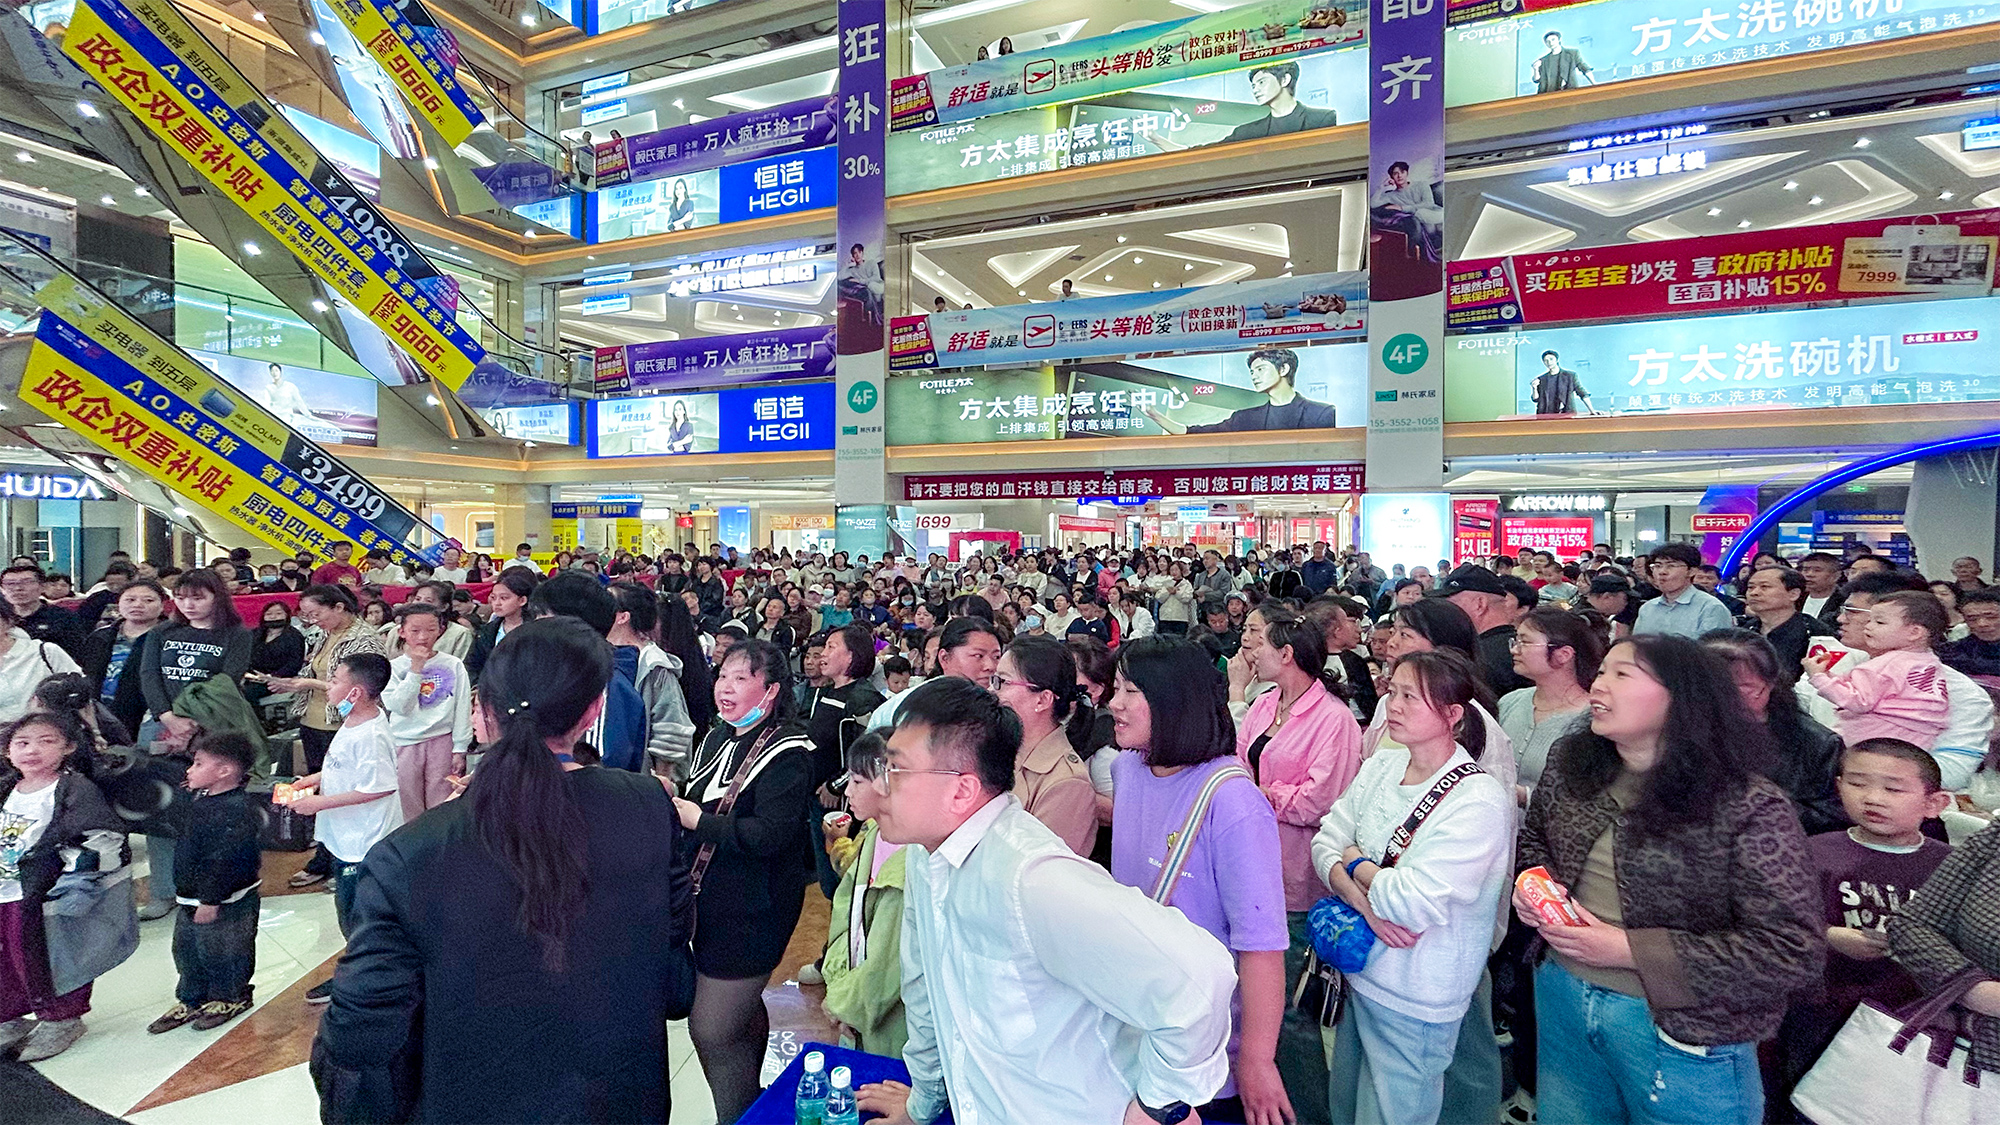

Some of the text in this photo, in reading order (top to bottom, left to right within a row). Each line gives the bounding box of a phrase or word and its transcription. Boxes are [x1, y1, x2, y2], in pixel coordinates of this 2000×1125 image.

[1188, 29, 1238, 49] 政企双补
[1459, 19, 1533, 41] FOTILE方太
[1631, 0, 1903, 57] 方太洗碗机
[134, 2, 231, 93] 买电器 到五层
[381, 5, 455, 90] 春季家装节
[1156, 44, 1173, 66] 沙发
[1189, 44, 1238, 62] 以旧换新
[1631, 40, 1791, 76] 颠覆传统水洗技术
[1807, 13, 1962, 48] 发明高能气泡洗
[1091, 47, 1154, 79] 头等舱
[387, 54, 444, 114] 9666
[947, 80, 1019, 108] 舒适 就是
[75, 33, 265, 202] 政企双重补贴
[435, 115, 445, 126] 元
[1196, 103, 1216, 114] X20
[704, 110, 827, 151] 万人疯狂抢工厂
[920, 123, 975, 142] FOTILE方太
[960, 107, 1192, 169] 方太集成烹饪中心
[843, 155, 880, 180] 30%
[997, 143, 1146, 178] 上排集成 引领高端厨电
[754, 161, 804, 190] 恒洁
[748, 187, 810, 213] HEGII
[259, 210, 361, 300] 热水器 净水机 油烟机 燃气灶
[272, 202, 369, 290] 厨电四件套
[1525, 245, 1835, 294] 买乐至宝沙发 享政府补贴
[1858, 271, 1897, 282] 7999
[1450, 278, 1504, 295] 无居然合同
[1451, 287, 1511, 305] 谁来保护你?
[1674, 272, 1827, 302] 至高补贴15%
[369, 291, 403, 323] 低至
[384, 267, 458, 337] 春季家装节
[1188, 305, 1238, 320] 政企双补
[1090, 314, 1155, 340] 头等舱
[1155, 312, 1173, 335] 沙发
[1188, 318, 1238, 333] 以旧换新
[390, 314, 445, 364] 9666
[947, 329, 1019, 353] 舒适 就是
[1458, 335, 1532, 349] FOTILE方太
[96, 320, 198, 392] 买电器 到五层
[703, 340, 826, 369] 万人疯狂抢工厂
[1388, 343, 1421, 365] 4F
[1628, 334, 1900, 388] 方太洗碗机
[437, 362, 447, 373] 元
[919, 377, 974, 389] FOTILE方太
[1194, 385, 1215, 395] X20
[1401, 390, 1436, 399] 林氏家居
[1628, 378, 1981, 408] 颠覆传统水洗技术 发明高能气泡洗 3.0
[753, 396, 805, 421] 恒洁
[852, 389, 873, 405] 4F
[958, 386, 1190, 422] 方太集成烹饪中心
[123, 381, 241, 457] A.O.史密斯
[995, 416, 1145, 435] 上排集成 引领高端厨电
[1370, 417, 1440, 427] 155-3552-1058
[32, 369, 235, 503] 政企双重补贴
[251, 422, 283, 446] COLMO
[748, 423, 810, 442] HEGII
[0, 474, 105, 499] HUIDA
[1510, 495, 1574, 511] ARROW
[229, 504, 257, 528] 热水器
[256, 522, 285, 543] 净水机
[916, 515, 951, 529] 1699
[1696, 517, 1747, 527] 送千元大礼
[1461, 539, 1491, 555] 以旧
[1507, 534, 1587, 547] 政府补贴15%
[1720, 536, 1734, 547] 好
[163, 640, 223, 657] CENTURIES
[161, 666, 210, 678] NETWORK
[1413, 795, 1437, 820] SEE
[1432, 772, 1459, 795] YOU
